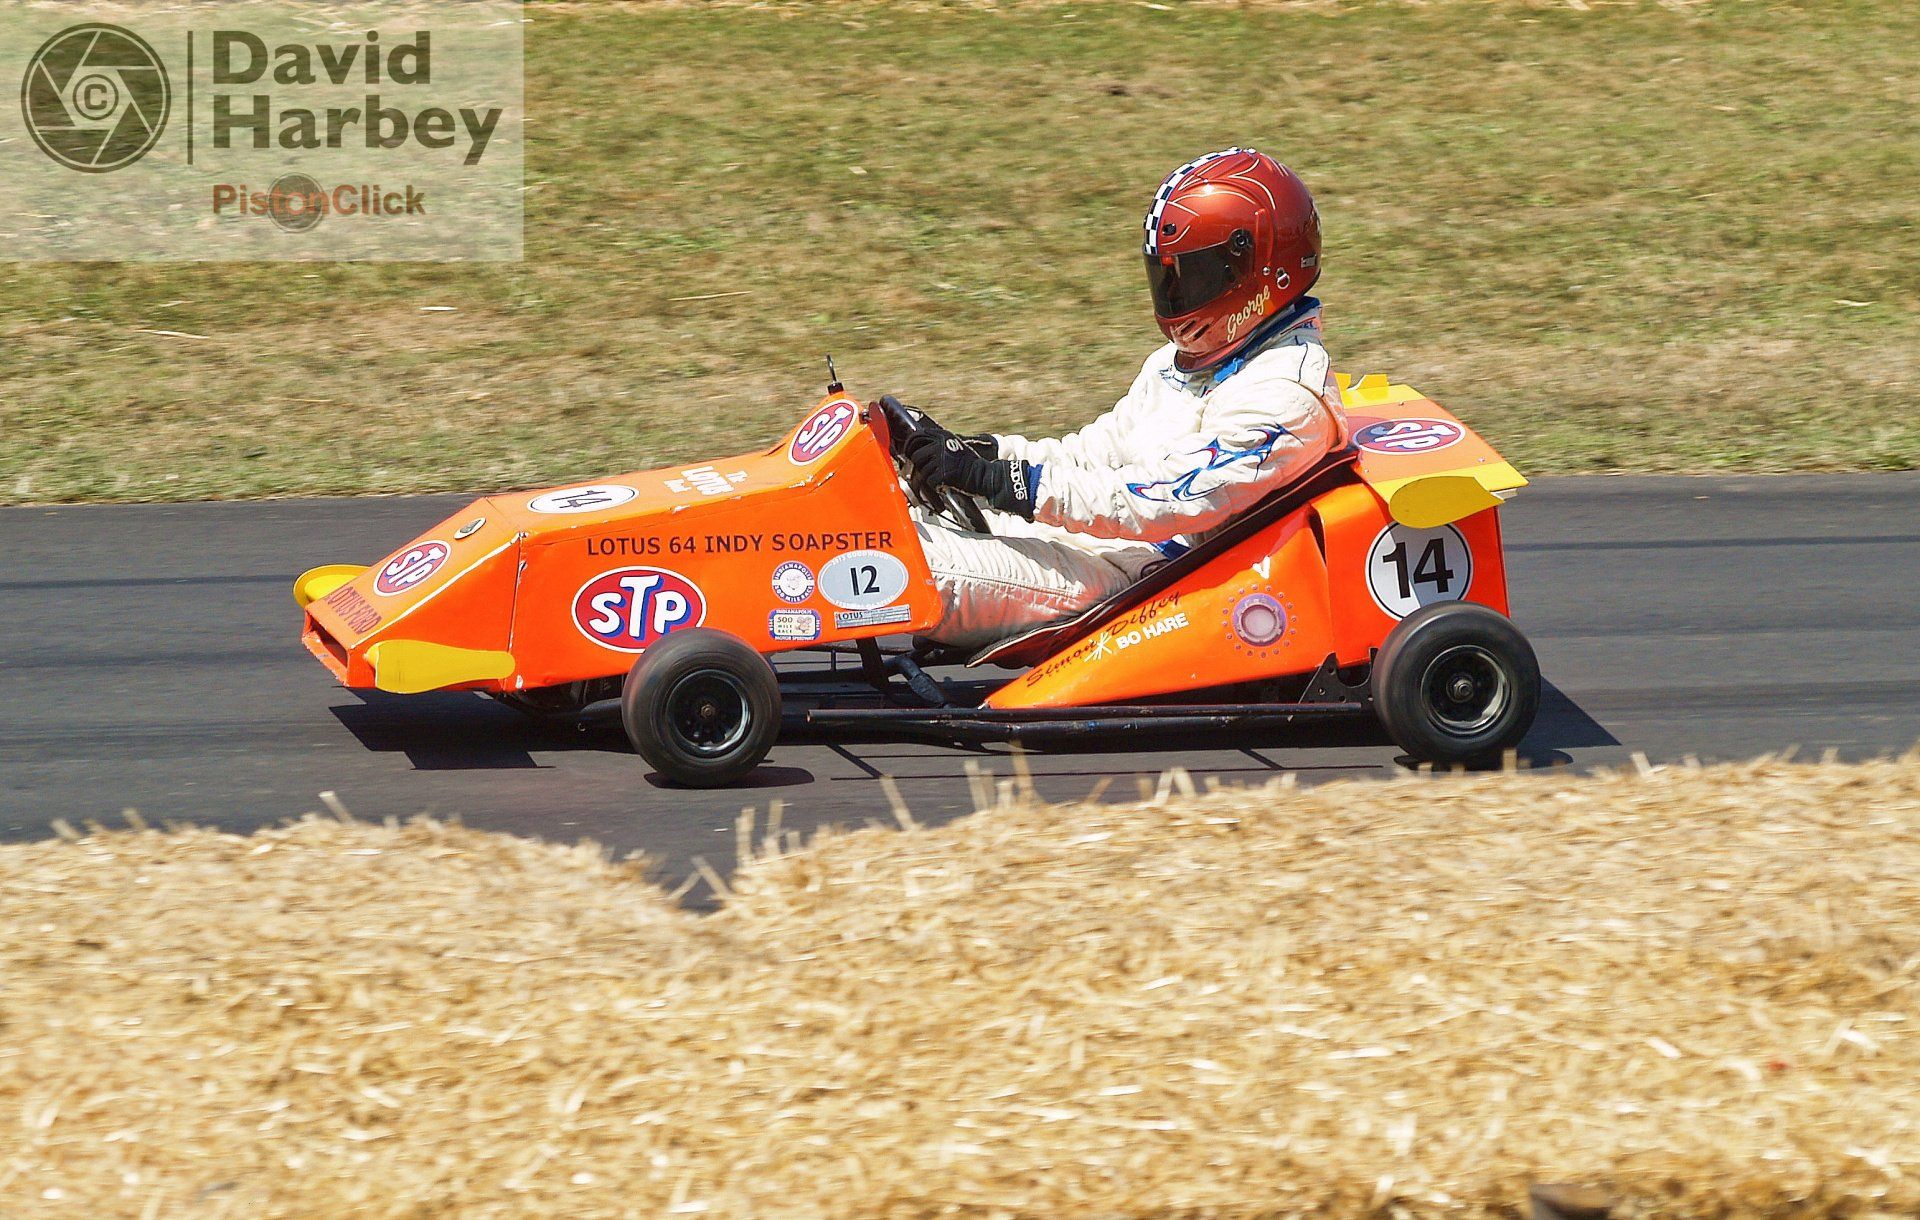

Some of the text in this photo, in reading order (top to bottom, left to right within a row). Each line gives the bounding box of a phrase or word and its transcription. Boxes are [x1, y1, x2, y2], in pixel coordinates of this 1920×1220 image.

[1226, 285, 1271, 343] George
[798, 406, 852, 455] STP
[1369, 421, 1457, 449] STP
[551, 490, 613, 509] 14
[587, 530, 894, 556] LOTUS 64 INDY SOAPSTER
[388, 546, 446, 588] STP
[849, 565, 880, 597] 12
[1382, 537, 1455, 600] 14
[588, 573, 692, 641] STP
[838, 611, 863, 620] LOTUS
[1115, 612, 1190, 649] BO HARE
